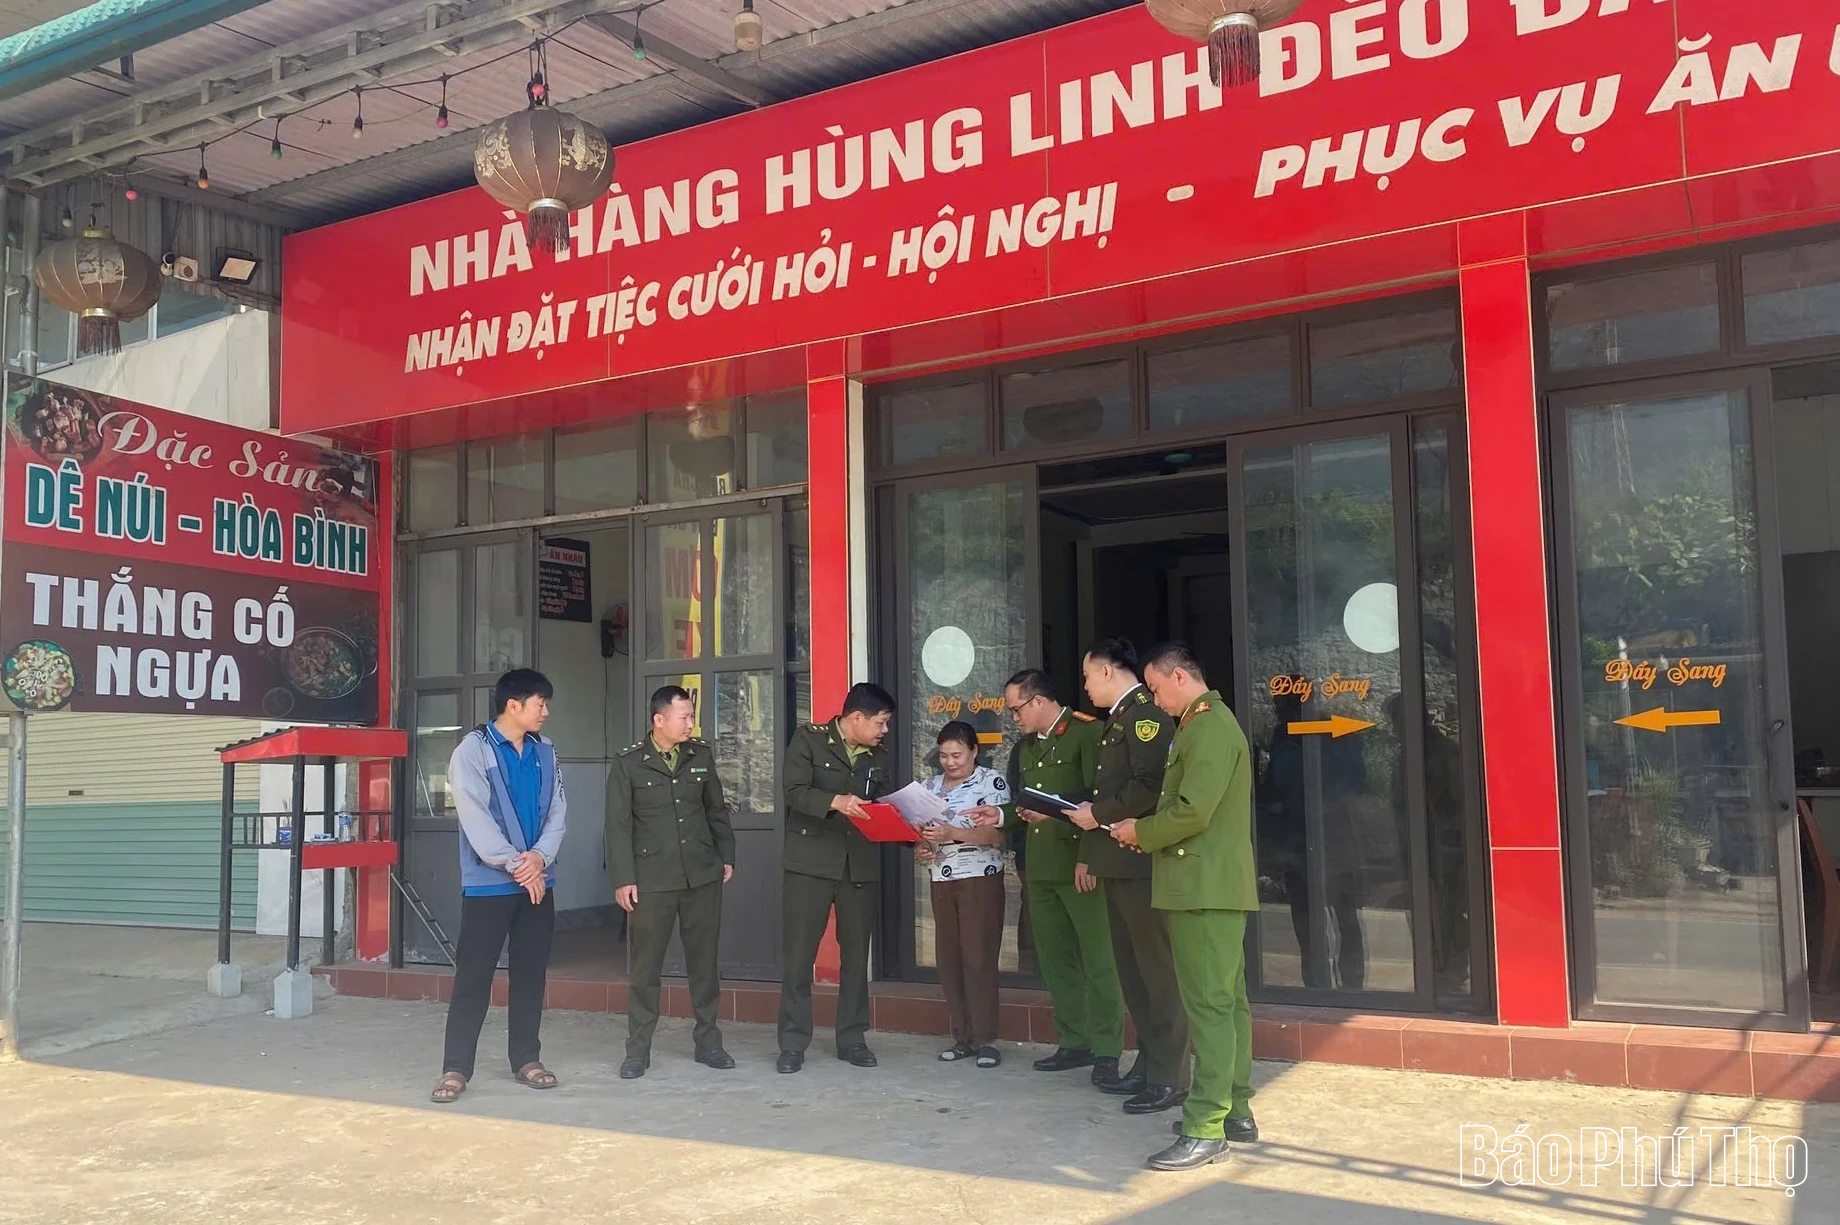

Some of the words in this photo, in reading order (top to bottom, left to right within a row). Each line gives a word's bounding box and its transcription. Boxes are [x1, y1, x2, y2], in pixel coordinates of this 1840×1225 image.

[404, 309, 501, 376] NHẬN
[506, 291, 577, 360] ĐẶT
[585, 274, 661, 345] TIỆC
[667, 246, 764, 321] CƯỚI
[771, 228, 853, 300] HỎI
[887, 203, 975, 284] HỘI
[985, 181, 1118, 257] NGHỊ
[1254, 107, 1476, 199] PHỤC
[1498, 73, 1623, 153] VỤ
[1645, 31, 1802, 114] ĂN
[409, 209, 533, 296] NHÀ
[554, 168, 739, 263] HÀNG
[765, 107, 983, 214] HÙNG
[1009, 45, 1223, 157] LINH
[97, 411, 213, 472] Đặc
[228, 440, 330, 495] Sản
[25, 458, 83, 533] DÊ
[95, 471, 167, 546] NÚI
[212, 493, 283, 563] HÒA
[292, 507, 368, 577] BÌNH
[25, 566, 213, 640] THẮNG
[233, 585, 296, 648] CỐ
[95, 644, 241, 710] NGỰA
[967, 691, 1005, 716] Sang
[1321, 672, 1371, 700] Sang
[1667, 657, 1727, 688] Sang
